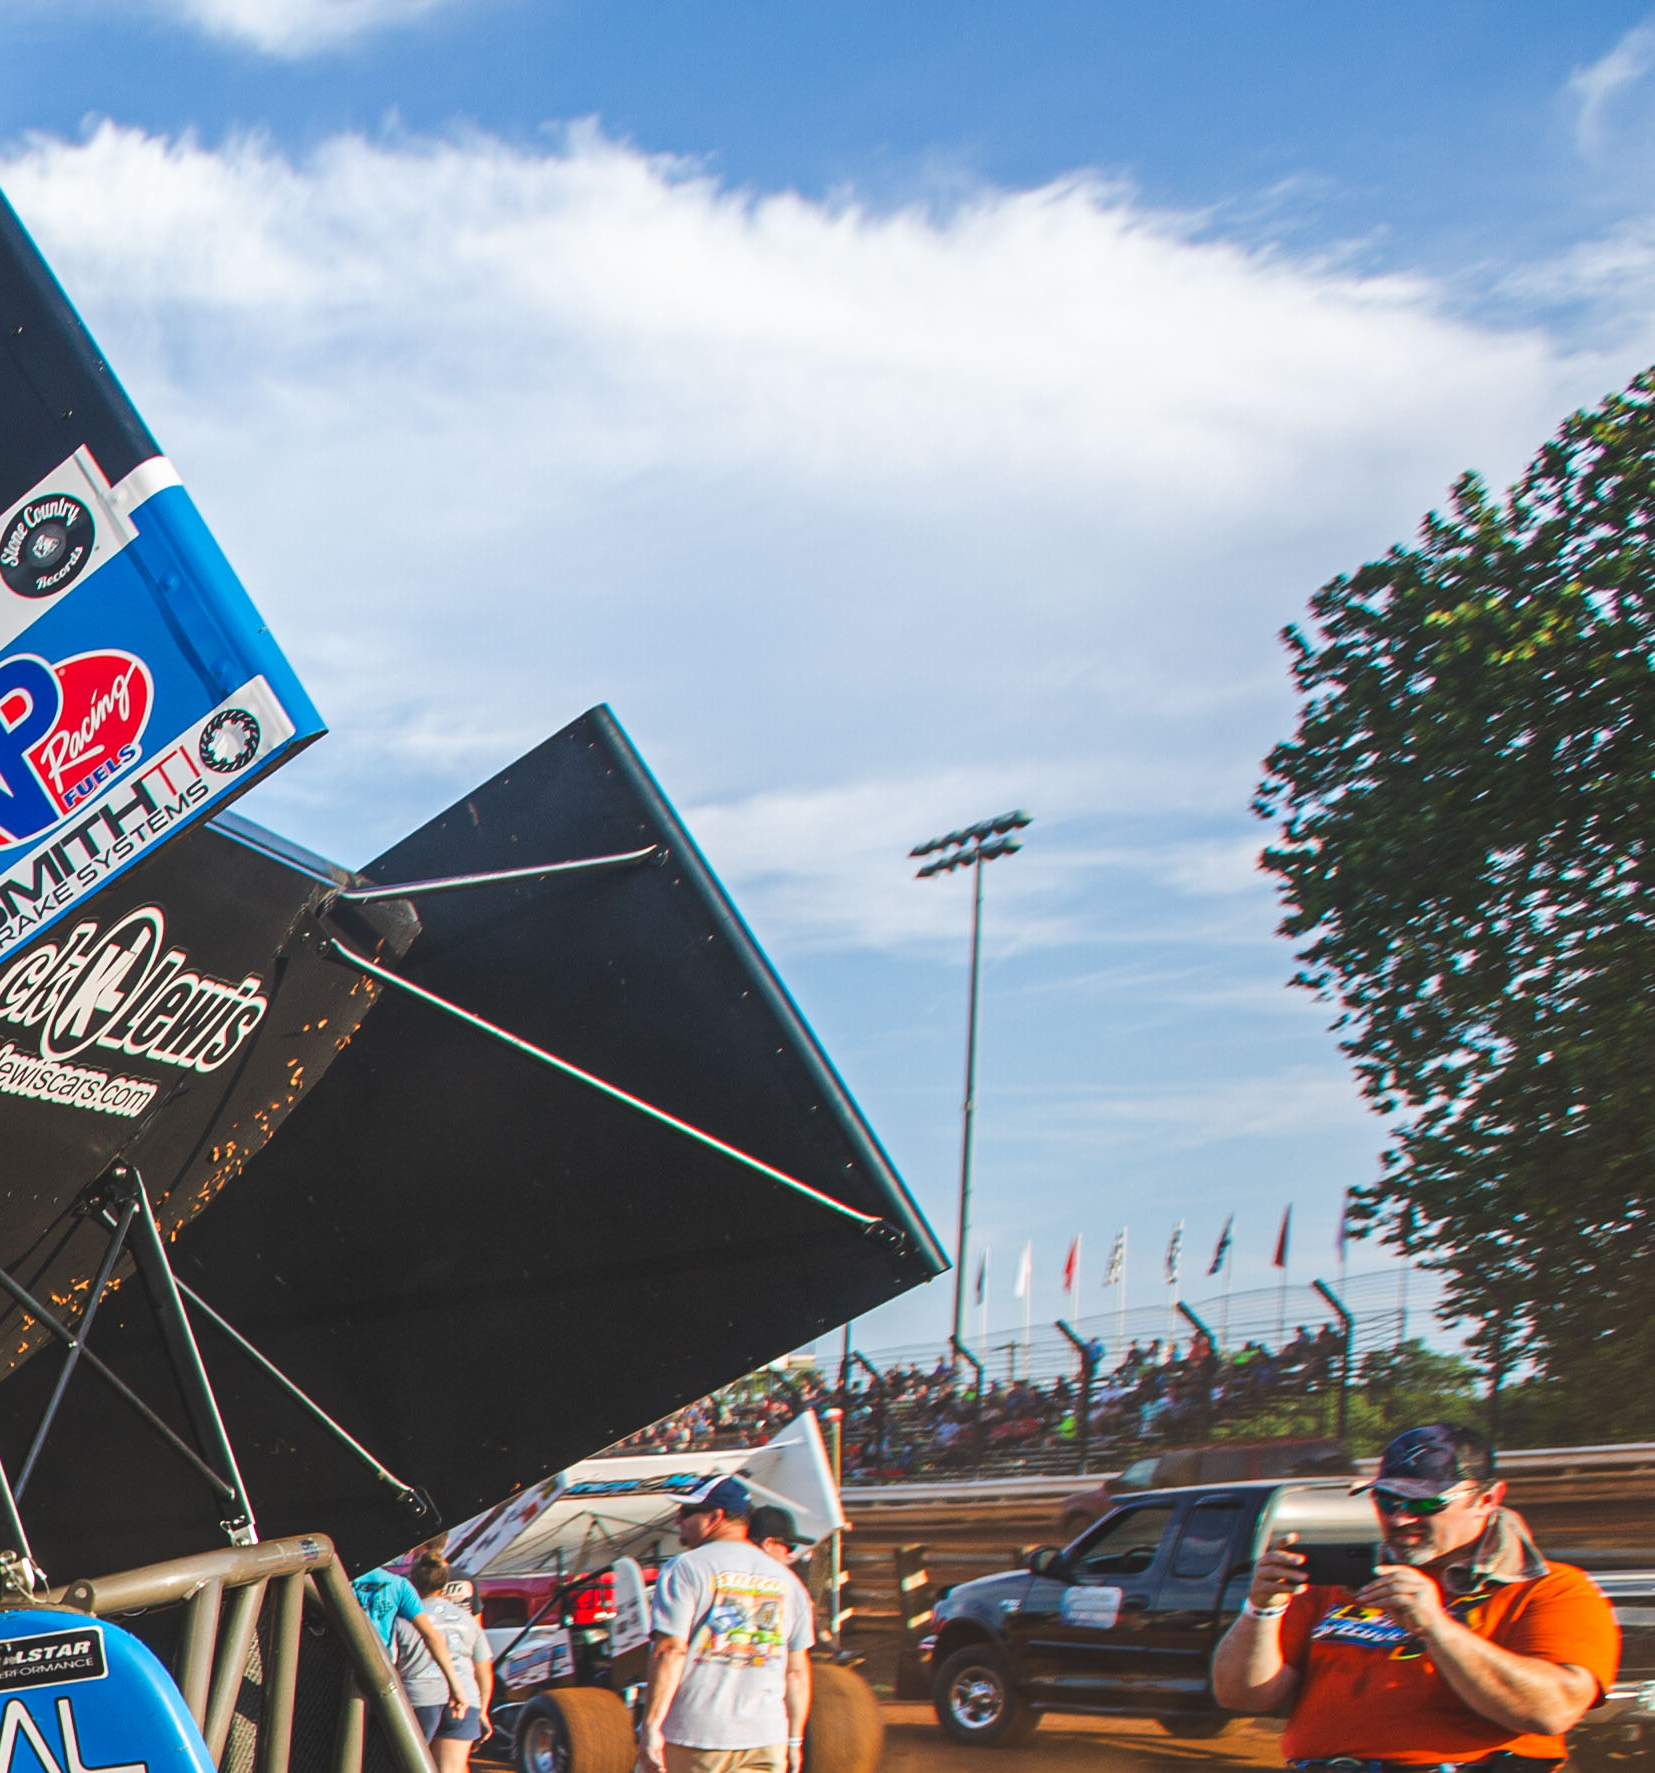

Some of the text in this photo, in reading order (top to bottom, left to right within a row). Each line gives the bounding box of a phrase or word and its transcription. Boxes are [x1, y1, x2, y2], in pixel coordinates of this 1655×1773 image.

[1, 521, 28, 567] Stone
[23, 497, 80, 528] Country
[35, 545, 84, 590] Records
[40, 662, 137, 795] Racing
[62, 745, 137, 811] FUELS
[76, 779, 209, 888] SYSTEMS
